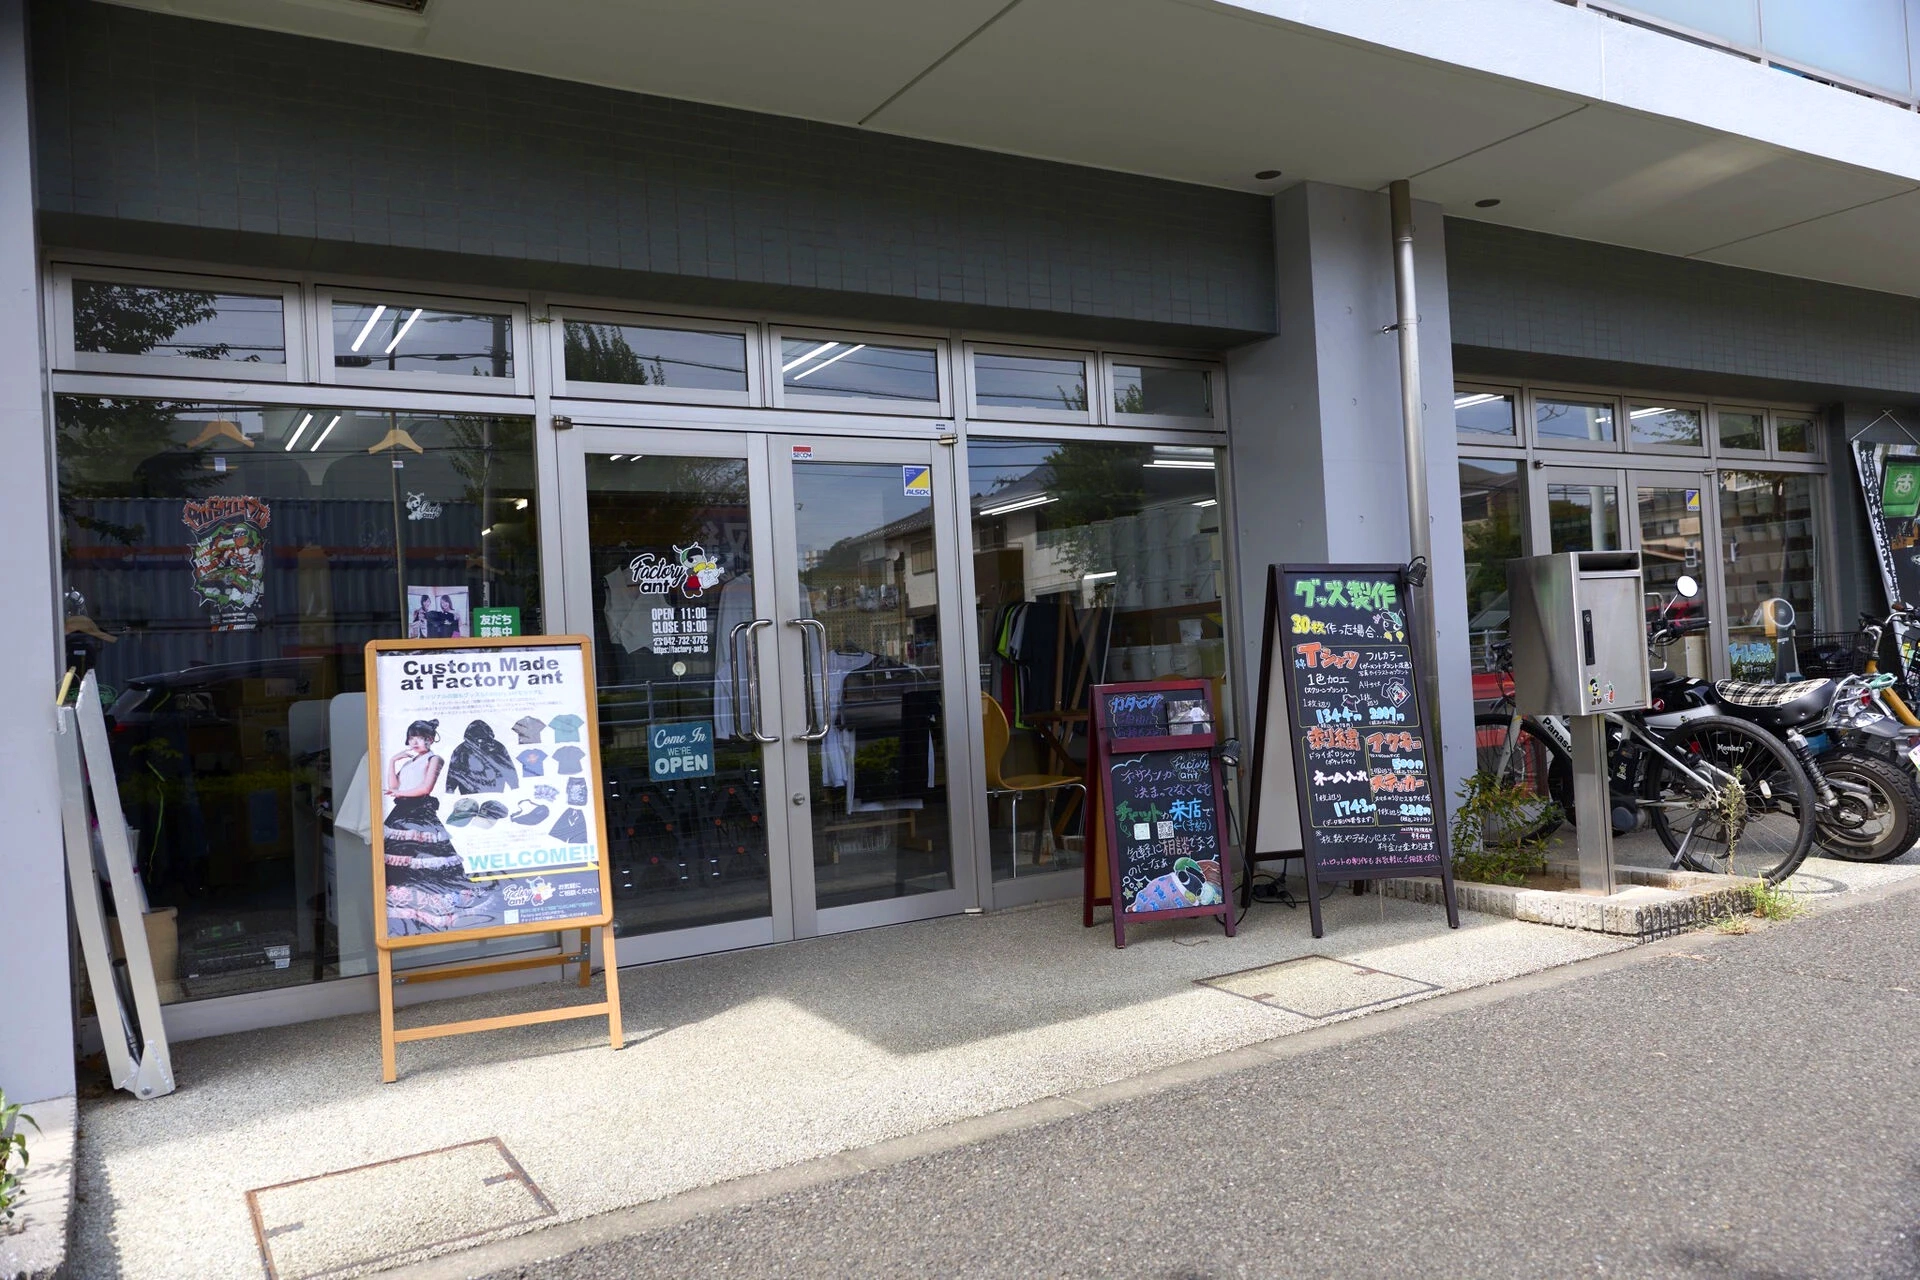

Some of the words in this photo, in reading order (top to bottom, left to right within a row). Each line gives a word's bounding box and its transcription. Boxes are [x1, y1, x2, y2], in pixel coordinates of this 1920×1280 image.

[905, 488, 930, 496] ALSOK
[630, 553, 685, 586] Factory
[639, 579, 671, 594] ant
[1295, 579, 1397, 610] グッズ製作
[480, 614, 512, 625] 友だち
[651, 608, 675, 621] OPEN
[680, 607, 707, 620] 11:00
[480, 627, 513, 637] 募集中
[652, 621, 679, 634] CLOSE
[682, 620, 708, 633] 19:00
[653, 645, 709, 655] https://factory-ant.jp
[1296, 642, 1360, 669] Tシャツ
[1365, 651, 1404, 661] フルカラー
[403, 659, 491, 676] Custom
[500, 656, 559, 672] Made
[401, 675, 424, 690] at
[432, 673, 519, 690] Factory
[527, 670, 564, 686] ant
[1307, 673, 1350, 686] 1色加工
[1111, 694, 1164, 713] カタログ
[1315, 706, 1362, 724] 1344円
[654, 729, 687, 749] Come
[689, 727, 707, 743] In
[1307, 726, 1361, 751] 刺繍
[667, 747, 692, 756] WE'RE
[1309, 750, 1356, 761] ドライポロシャツ
[1717, 743, 1745, 754] Monkey
[654, 754, 708, 774] OPEN
[1392, 758, 1424, 770] 500円
[1121, 767, 1175, 785] デザインが
[1180, 771, 1199, 779] ant
[1313, 770, 1369, 787] ネーム入れ
[1371, 774, 1425, 793] ステッカー
[1134, 782, 1212, 799] 決まってなくても
[1334, 799, 1377, 818] 1743円
[1127, 835, 1216, 862] 気軽に相談できる
[1378, 842, 1435, 852] 料金は変わります
[468, 845, 596, 871] WELCOME!!
[503, 883, 533, 901] Factory
[558, 887, 600, 897] ご相談ください
[508, 896, 527, 906] ant
